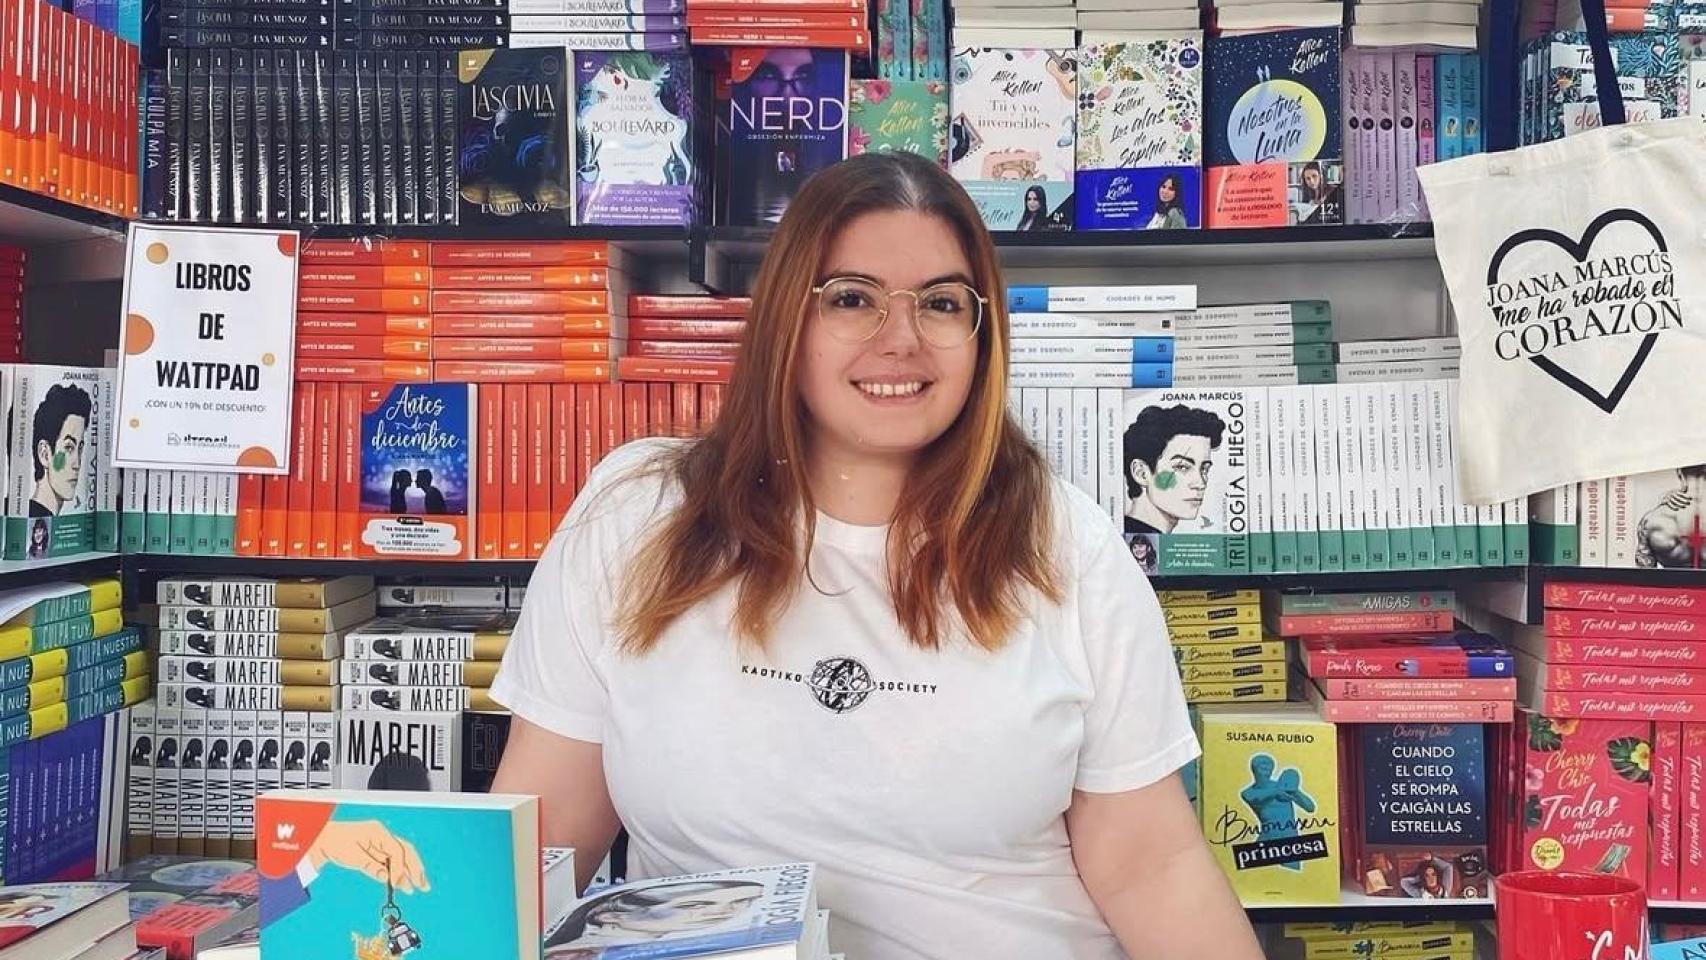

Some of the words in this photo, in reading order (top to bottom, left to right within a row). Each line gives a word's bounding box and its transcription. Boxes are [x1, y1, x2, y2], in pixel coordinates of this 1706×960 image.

[1297, 39, 1323, 55] Alice
[1288, 50, 1328, 74] Kellen
[991, 70, 1017, 82] Alice
[1003, 80, 1043, 98] Kellen
[472, 84, 555, 120] LASCIVIA
[730, 96, 846, 131] NERD
[1112, 97, 1145, 115] Kellen
[148, 97, 165, 134] CULPA
[977, 115, 1050, 130] invencibles
[1131, 108, 1166, 132] alas
[1238, 94, 1303, 136] Nosotros
[592, 118, 676, 137] BOULEVARD
[148, 140, 161, 168] MÍA
[1119, 138, 1167, 169] Sophie
[1255, 130, 1302, 164] Luna
[481, 203, 502, 213] EVA
[176, 262, 251, 292] LIBROS
[1487, 272, 1570, 307] JOANA
[1574, 250, 1673, 284] MARCÚS
[1499, 305, 1532, 328] me
[1537, 296, 1567, 319] ha
[1572, 276, 1645, 308] robado
[198, 313, 225, 340] DE
[1495, 295, 1683, 361] CORAZÓN
[156, 360, 260, 391] WATTPAD
[203, 403, 213, 411] DE
[386, 386, 445, 420] Antes
[1160, 393, 1195, 401] JOANA
[1199, 392, 1243, 401] MARCÚS
[371, 419, 460, 451] diciembre
[1228, 402, 1244, 467] FUEGO
[1226, 475, 1245, 569] TRILOGÍA
[73, 595, 91, 611] TUY
[221, 583, 274, 606] MARFIL
[1362, 595, 1411, 610] AMIGAS
[1579, 590, 1615, 606] Todas
[1616, 594, 1635, 604] mis
[1639, 594, 1696, 608] respuestas
[71, 625, 91, 637] TUY
[224, 610, 277, 632] MARFIL
[1581, 618, 1617, 634] Todas
[1618, 621, 1637, 630] mis
[1641, 620, 1695, 637] respuestas
[224, 634, 277, 656] MARFIL
[411, 637, 470, 660] MARFIL
[1583, 645, 1619, 661] Todas
[1620, 648, 1638, 658] mis
[1641, 647, 1696, 664] respuestas
[9, 664, 30, 680] NUE
[225, 661, 281, 683] MARFIL
[408, 663, 463, 686] MARFIL
[741, 665, 803, 682] KAOTIKO
[879, 681, 937, 694] SOCIETY
[1582, 672, 1617, 688] Todas
[1618, 675, 1637, 685] mis
[1641, 672, 1694, 689] respuestas
[8, 692, 29, 710] NUE
[225, 687, 281, 710] MARFIL
[410, 688, 468, 711] MARFIL
[1580, 699, 1616, 715] Todas
[1617, 702, 1636, 712] mis
[1639, 700, 1694, 716] respuestas
[7, 721, 29, 740] NUE
[1226, 732, 1274, 743] SUSANA
[1277, 733, 1315, 743] RUBIO
[348, 719, 444, 771] MARFIL
[1392, 746, 1455, 758] CUANDO
[1395, 765, 1410, 777] EL
[1413, 765, 1453, 777] CIELO
[1545, 749, 1597, 773] Cherry
[1659, 756, 1674, 791] Todas
[1391, 783, 1407, 796] SE
[1410, 783, 1459, 796] ROMPA
[129, 775, 152, 835] MARFIL
[154, 778, 178, 838] MARFIL
[180, 778, 204, 838] MARFIL
[206, 779, 229, 838] MARFIL
[231, 779, 254, 839] MARFIL
[1379, 802, 1388, 814] Y
[1390, 801, 1445, 814] CAIGAN
[1447, 802, 1471, 815] LAS
[1540, 782, 1619, 832] Todas
[1209, 804, 1336, 848] Buonasera
[1391, 820, 1462, 833] ESTRELLAS
[1573, 817, 1598, 830] mis
[1560, 820, 1634, 851] respuestas
[1657, 812, 1674, 867] respuestas
[1237, 838, 1325, 869] princesa
